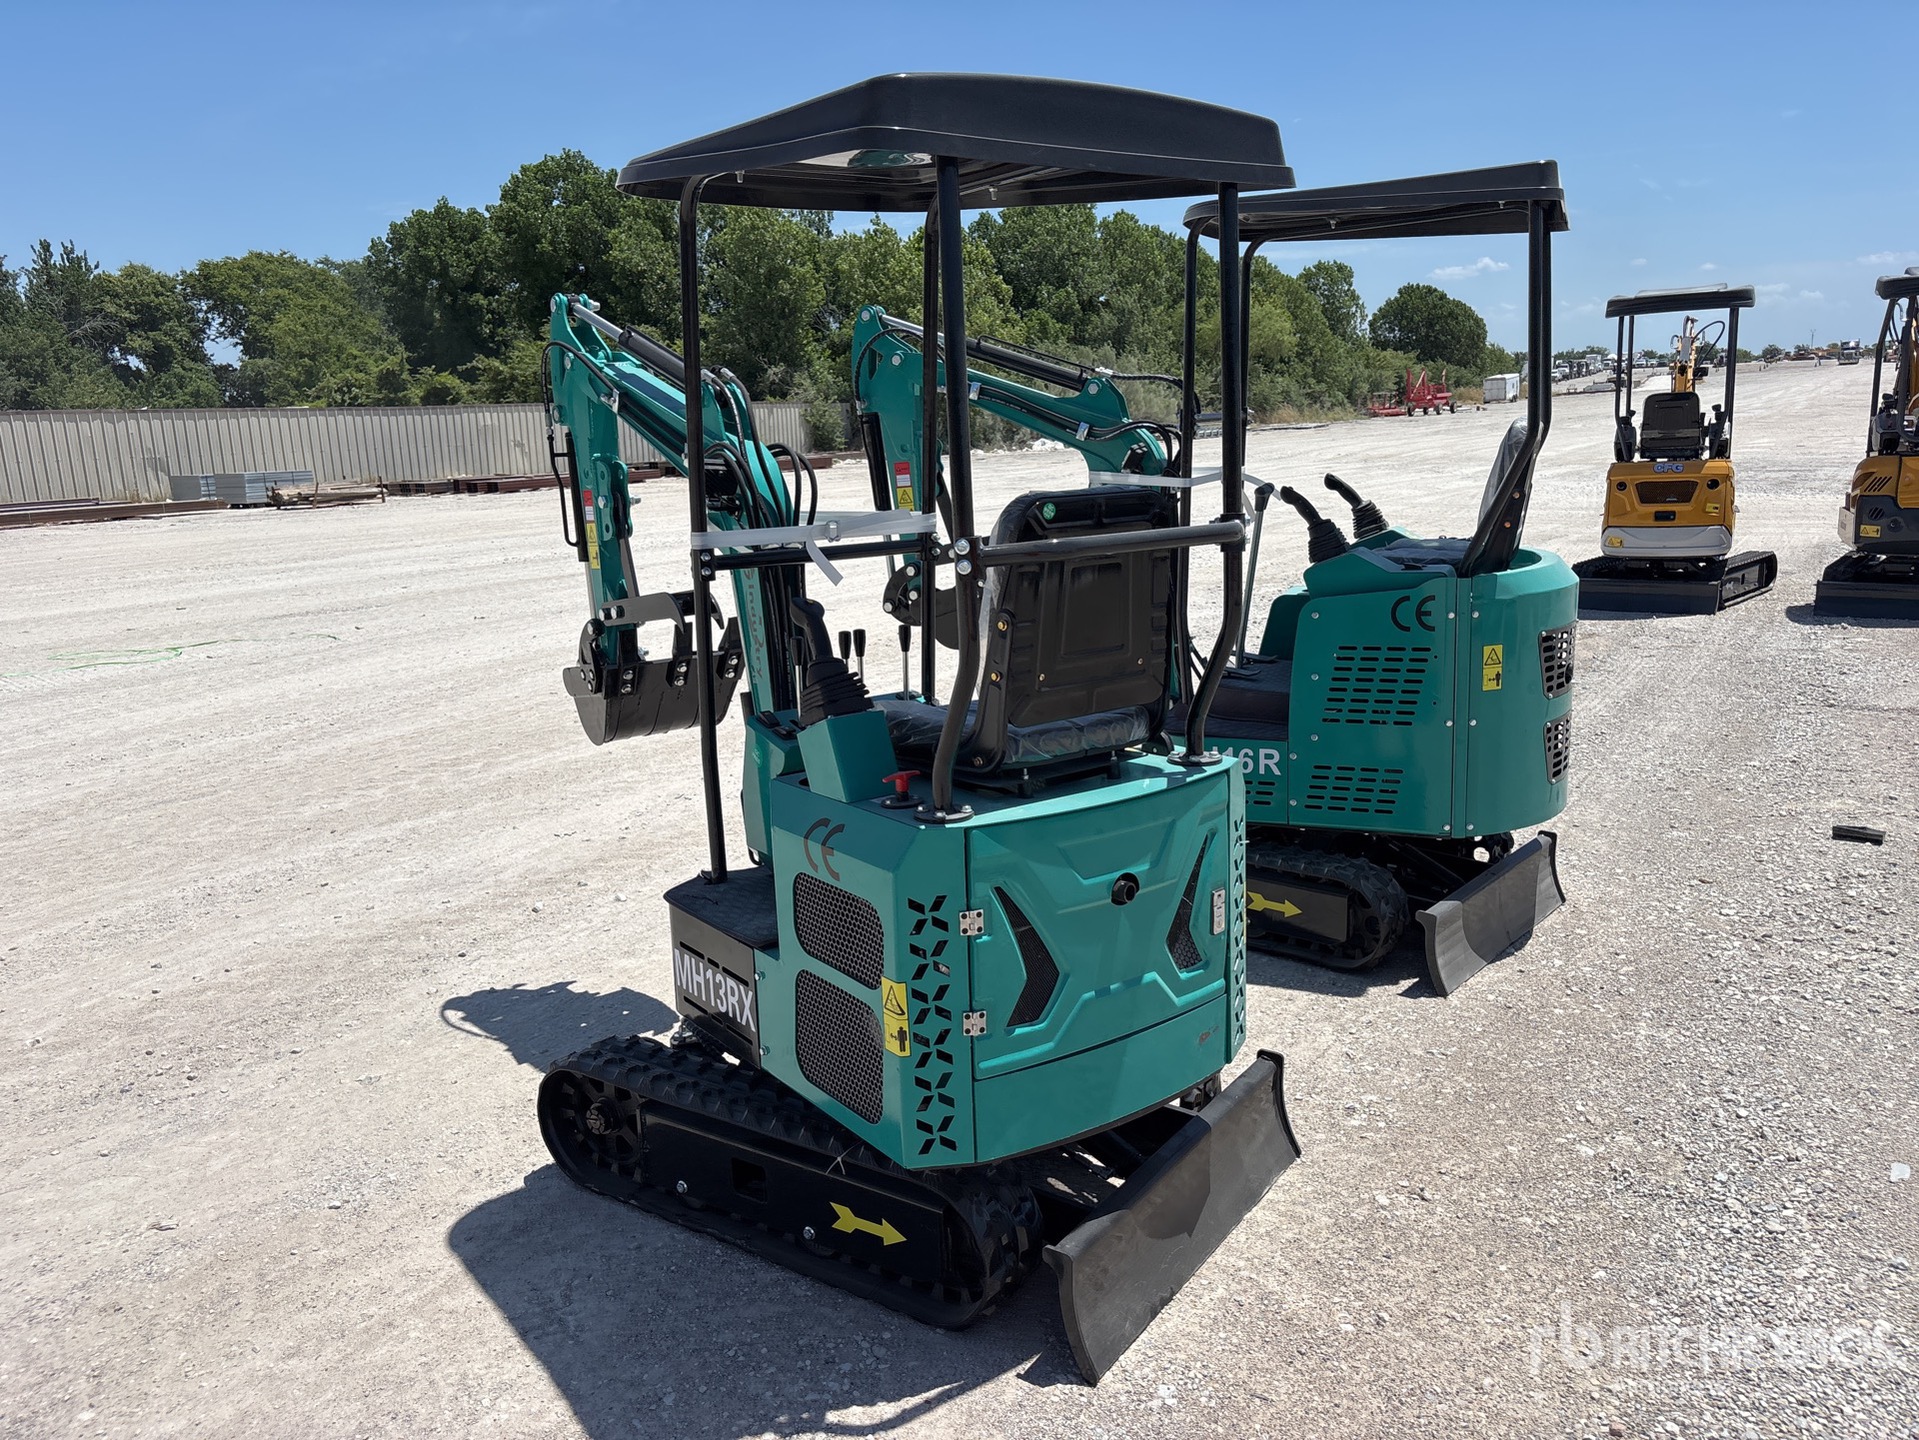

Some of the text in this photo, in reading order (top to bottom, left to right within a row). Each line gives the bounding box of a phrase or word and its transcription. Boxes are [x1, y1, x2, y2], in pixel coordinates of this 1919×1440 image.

[1391, 595, 1436, 632] CE
[803, 817, 846, 882] CE
[674, 948, 757, 1032] MH13RX
